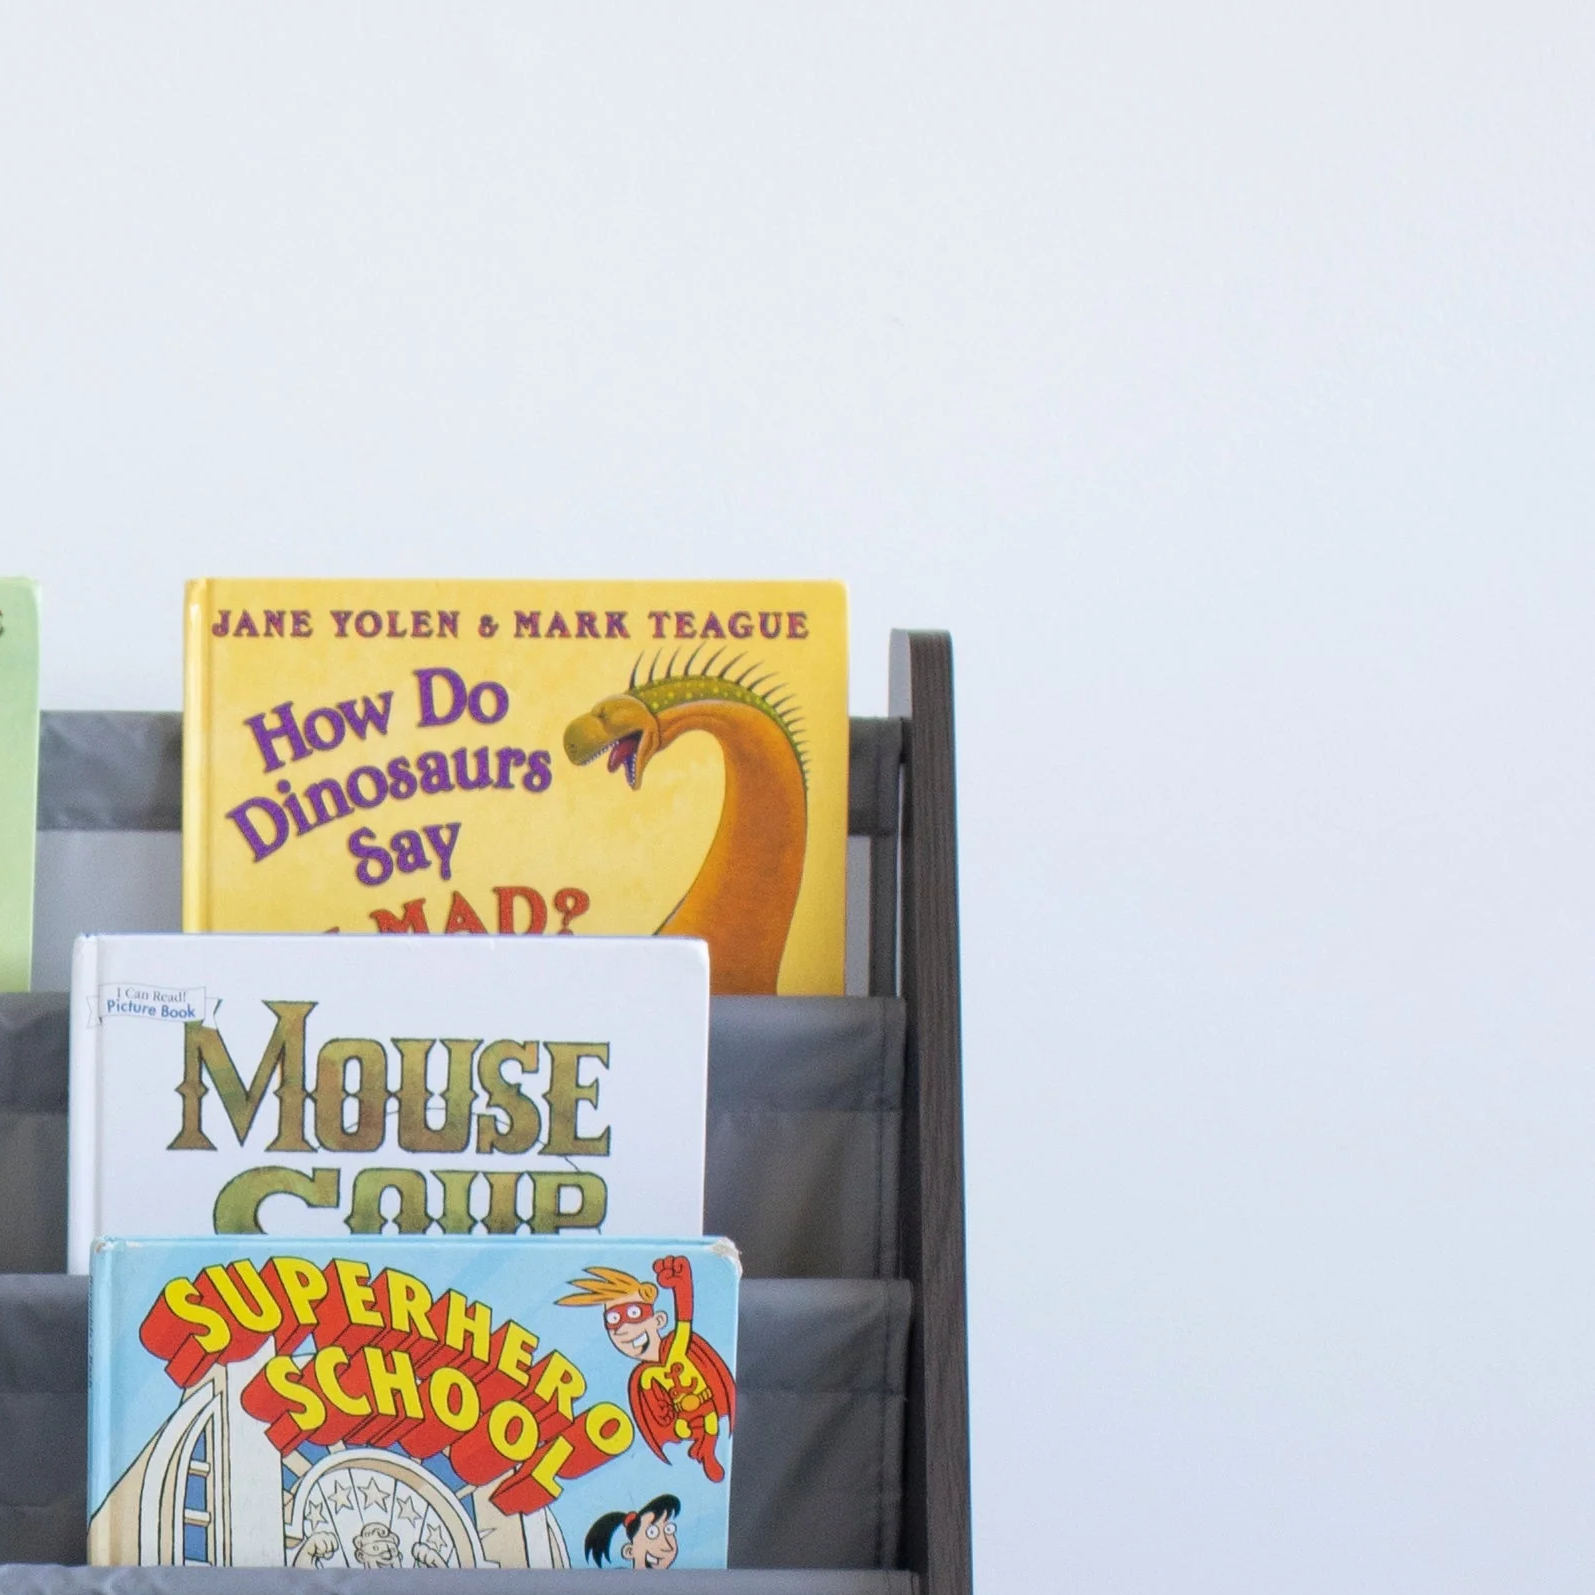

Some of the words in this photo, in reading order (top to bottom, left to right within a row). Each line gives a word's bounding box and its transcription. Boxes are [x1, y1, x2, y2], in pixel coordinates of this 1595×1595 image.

[212, 609, 314, 638] JANE
[330, 609, 461, 639] YOLEN
[477, 611, 499, 638] &
[513, 611, 631, 639] MARK
[648, 611, 810, 640] TEAGUE
[245, 689, 394, 774] How
[412, 666, 510, 728] Do
[226, 745, 553, 863] Dinosaurs
[347, 821, 462, 888] Say
[107, 999, 157, 1017] Picture
[161, 1003, 196, 1019] Book
[116, 987, 122, 999] I
[125, 987, 149, 1001] Can
[153, 991, 187, 1003] Read!
[166, 999, 612, 1158] MOUSE
[161, 1255, 636, 1458] SUPERHERO
[263, 1345, 575, 1500] SCHOOL
